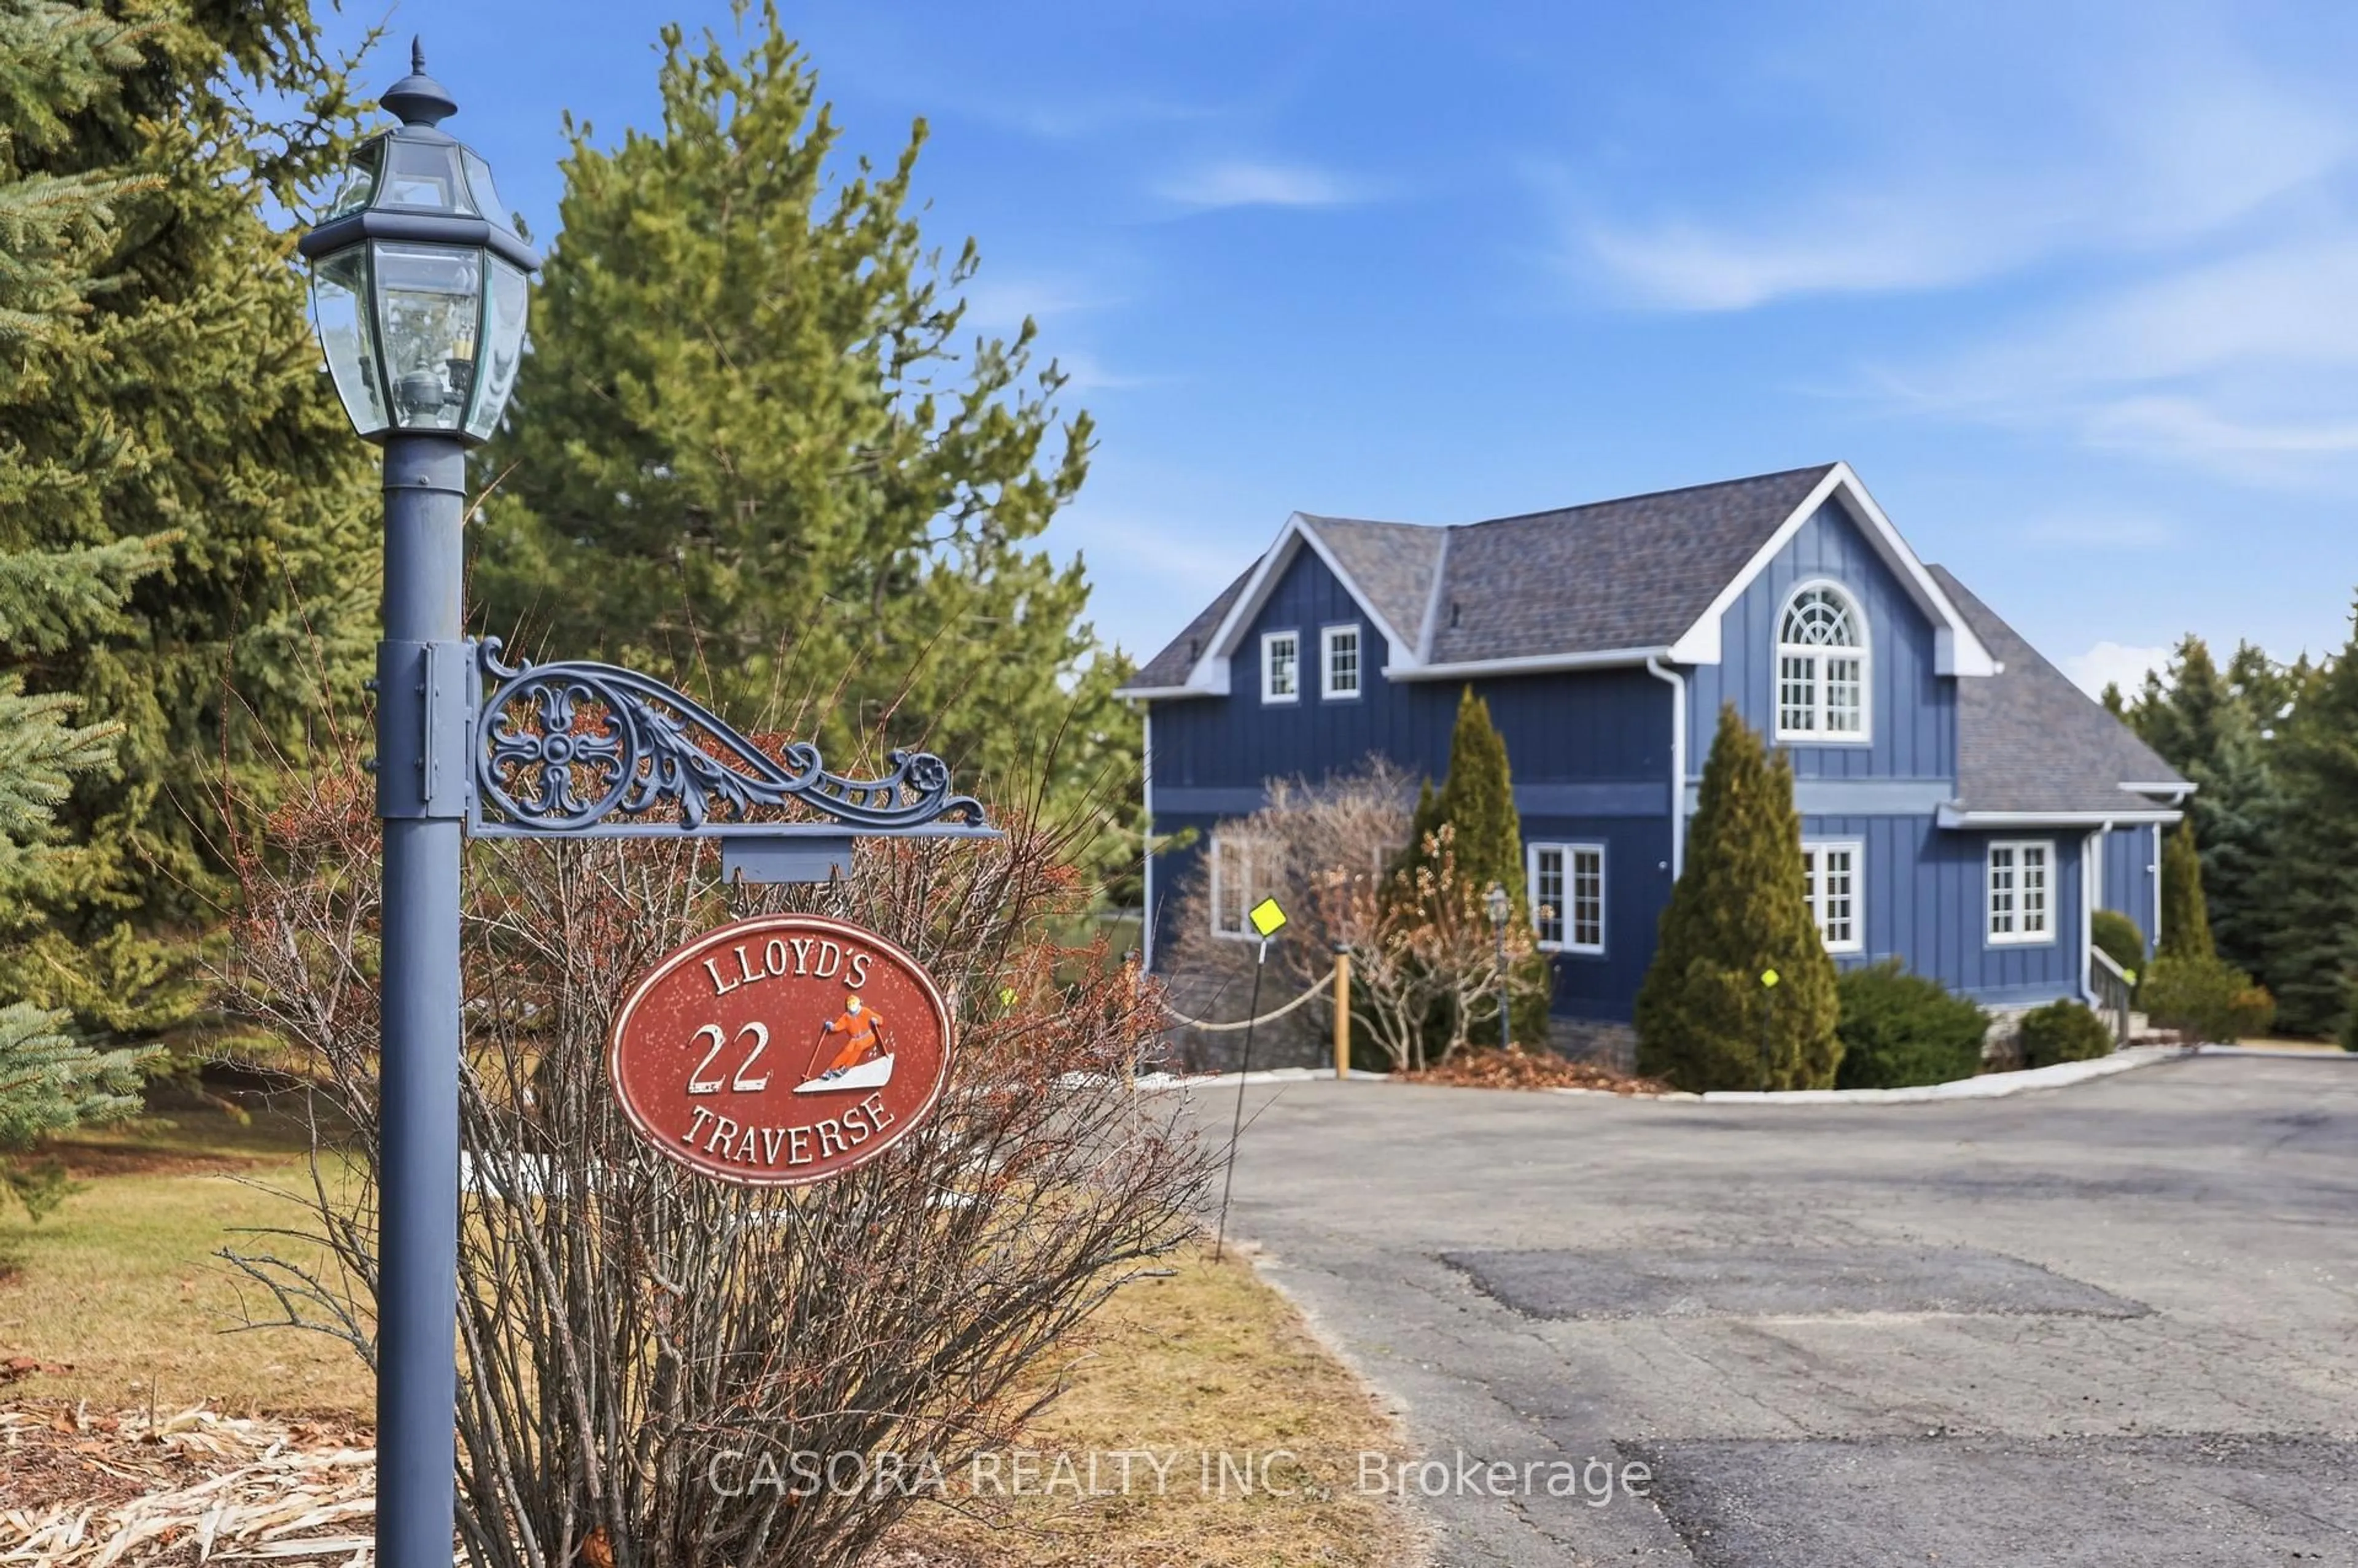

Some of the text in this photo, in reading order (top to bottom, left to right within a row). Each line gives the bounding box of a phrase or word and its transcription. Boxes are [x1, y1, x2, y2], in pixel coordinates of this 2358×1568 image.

[704, 938, 872, 995] LLOYD'S
[688, 1022, 770, 1093] 22
[682, 1092, 895, 1165] TRAVERSE
